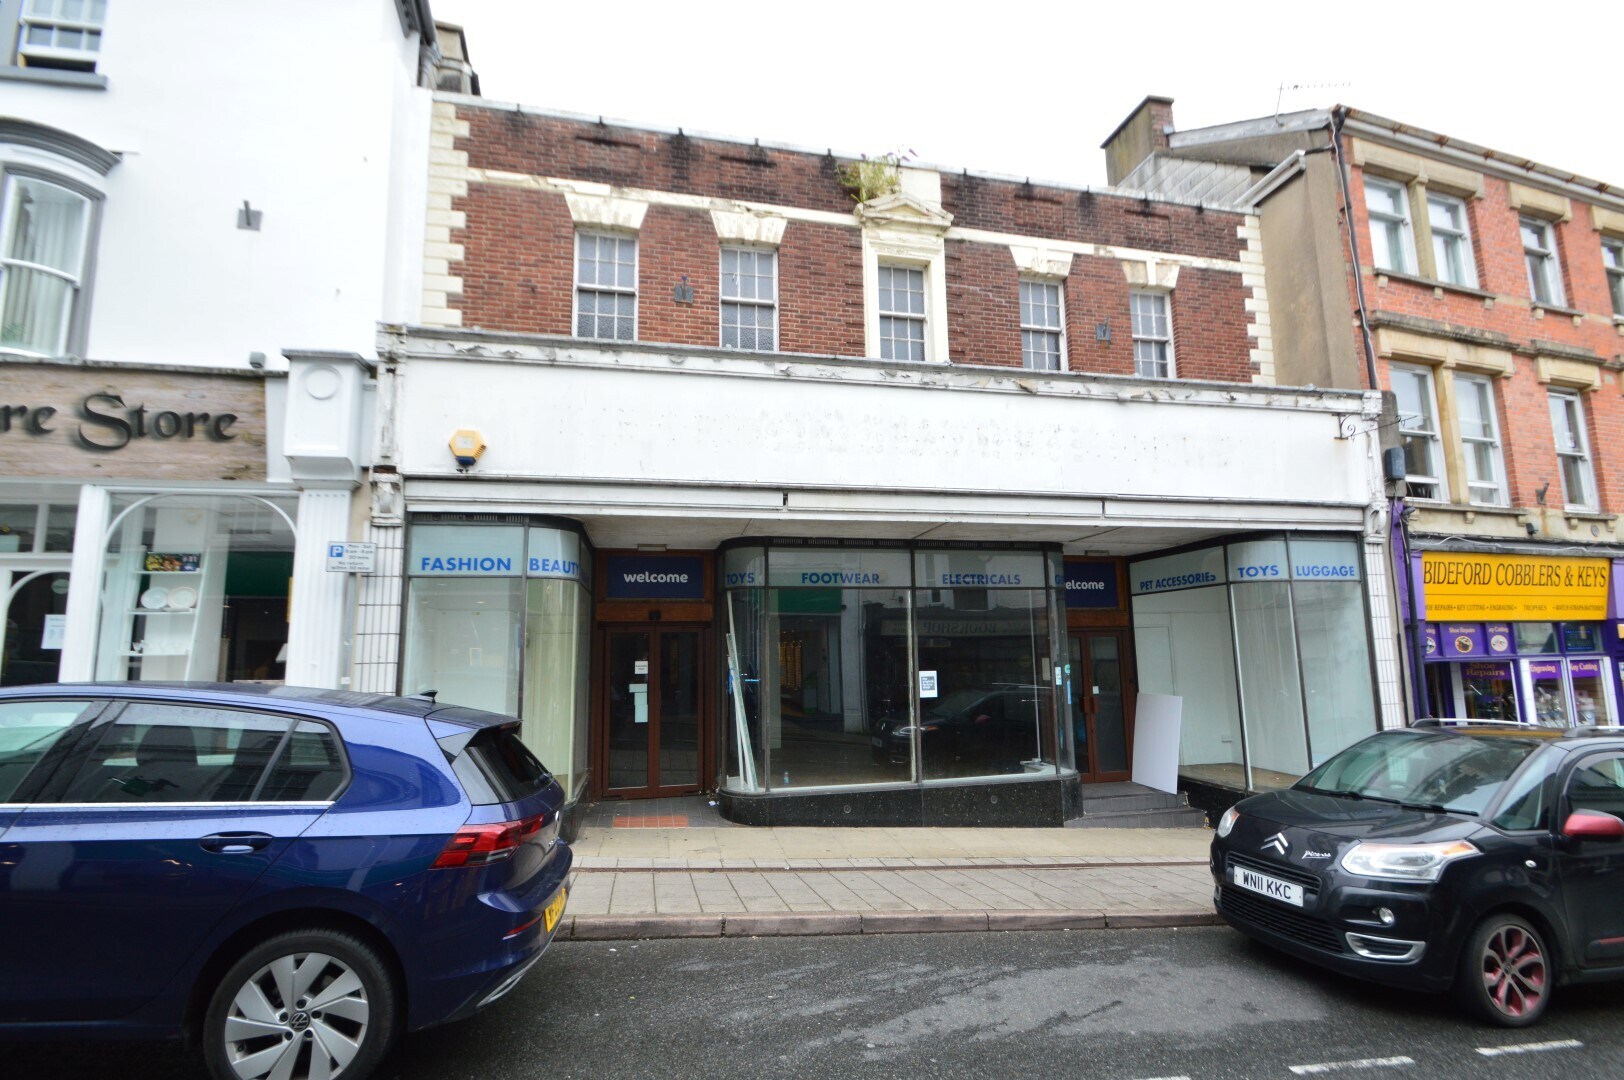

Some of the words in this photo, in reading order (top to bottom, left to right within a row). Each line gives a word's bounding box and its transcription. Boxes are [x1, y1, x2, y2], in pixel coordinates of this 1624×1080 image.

[79, 393, 238, 451] Store
[421, 557, 512, 571] FASHION
[623, 571, 689, 583] welcome
[1237, 565, 1279, 578] TOYS
[1296, 565, 1355, 577] LUGGAGE
[1423, 561, 1492, 585] BIDEFORD
[1495, 563, 1561, 587] COBBLERS
[1564, 565, 1574, 586] &
[1577, 566, 1606, 588] KEYS
[801, 572, 880, 584] FOOTWEAR
[942, 573, 1022, 585] ELECTRICALS
[1065, 579, 1105, 590] elcome
[1140, 580, 1154, 591] PET
[1466, 668, 1505, 677] Repairs
[1243, 871, 1263, 891] WN11
[1266, 879, 1291, 900] KKC
